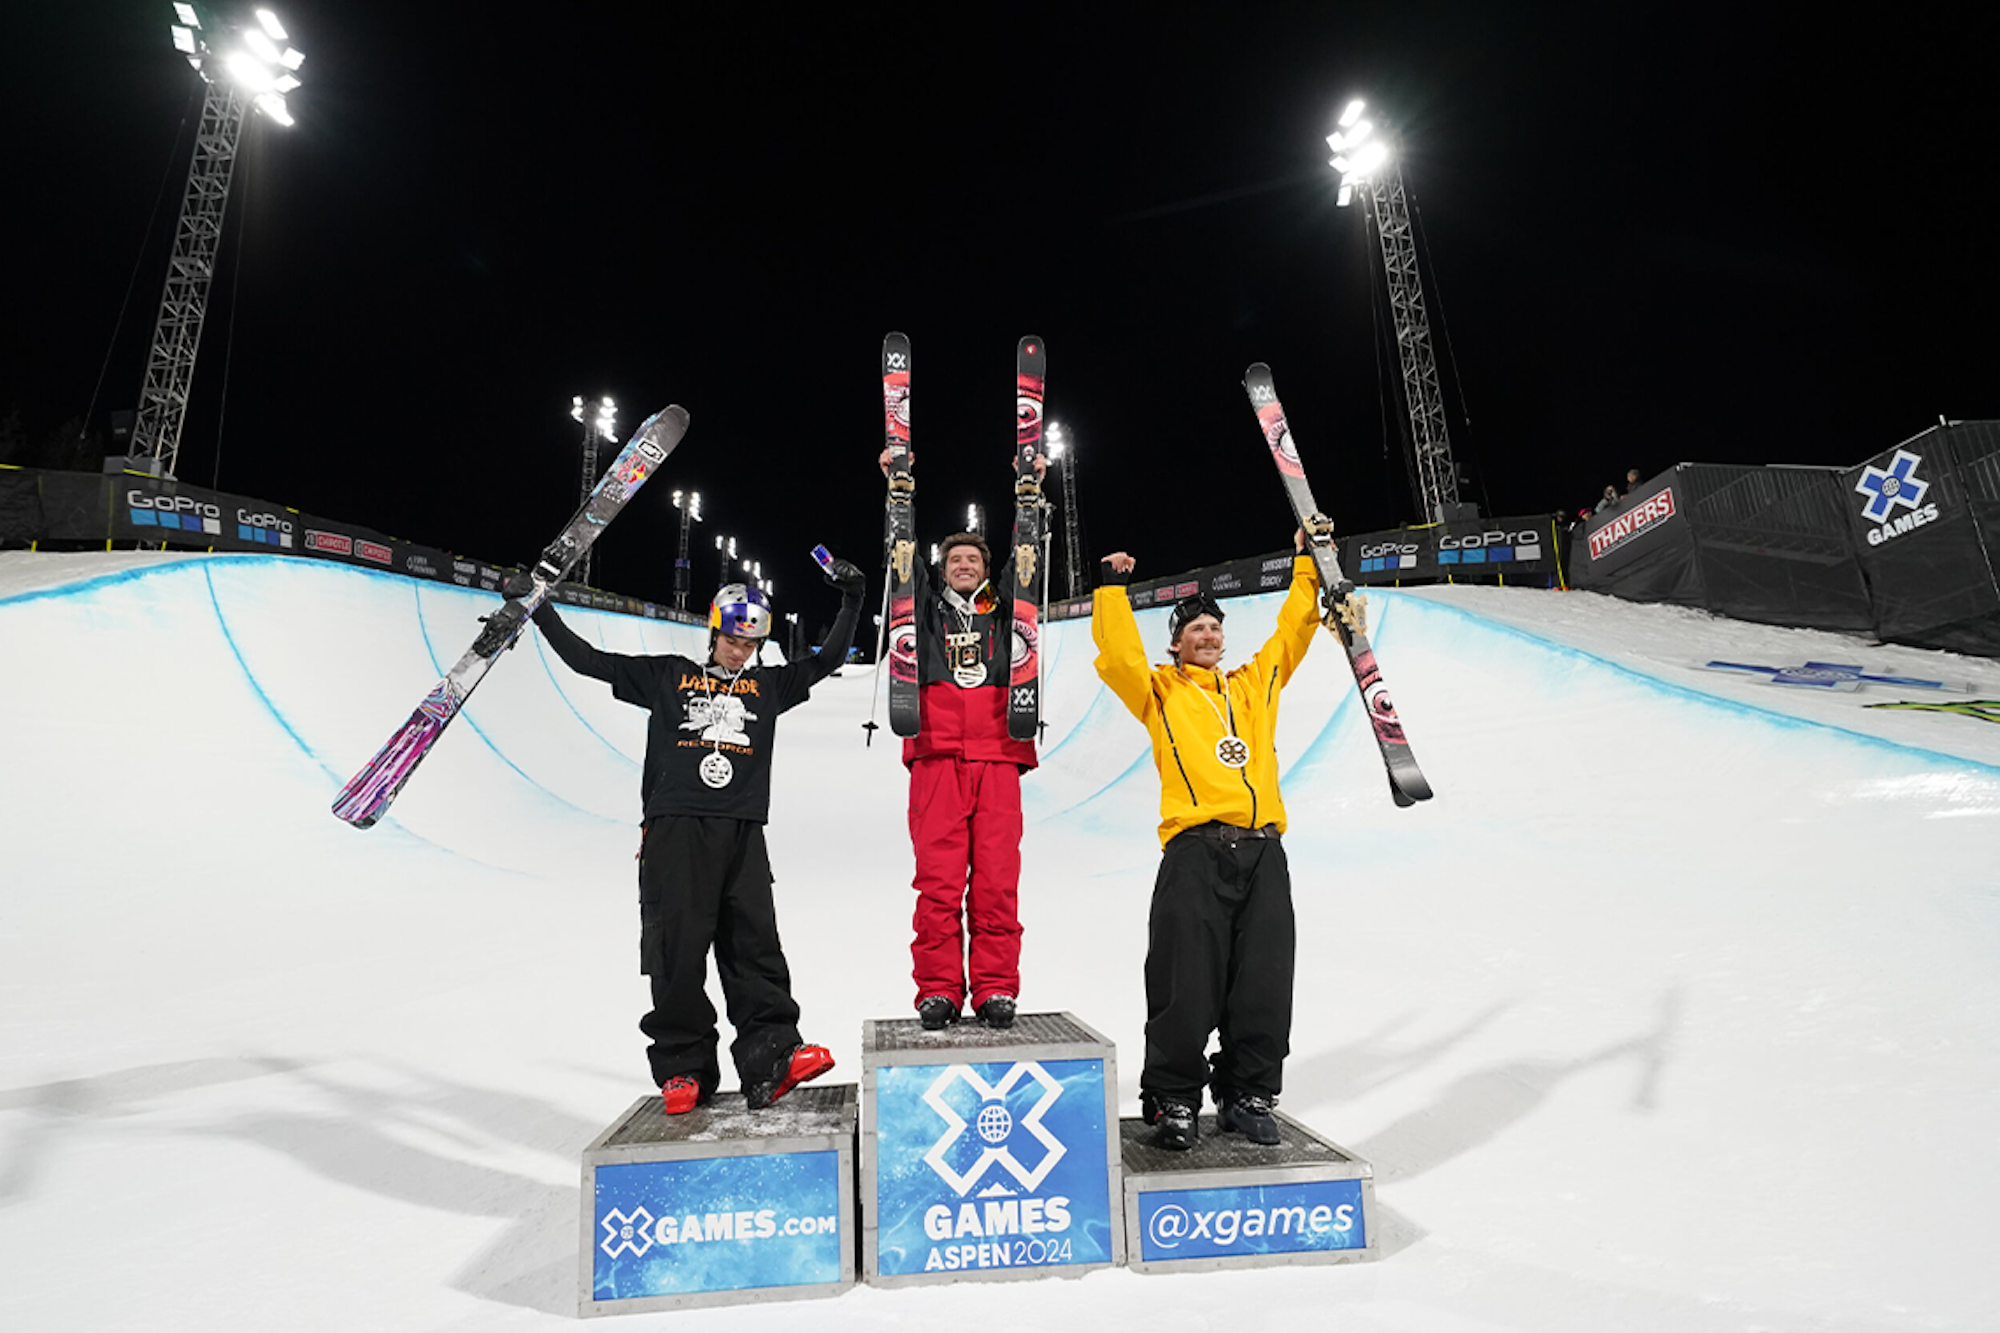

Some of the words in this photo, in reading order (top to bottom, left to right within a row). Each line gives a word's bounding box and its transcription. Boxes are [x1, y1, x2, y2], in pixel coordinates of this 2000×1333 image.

[127, 490, 220, 518] GoPro
[237, 508, 293, 533] GoPro
[1592, 495, 1670, 553] THAYERS
[1867, 502, 1939, 546] GAMES
[1361, 542, 1419, 558] GoPro
[1439, 530, 1539, 549] GoPro
[945, 631, 982, 646] TOP
[923, 1196, 1072, 1241] GAMES
[1149, 1203, 1354, 1249] @xgames
[924, 1242, 1011, 1271] ASPEN
[1013, 1238, 1073, 1265] 2024
